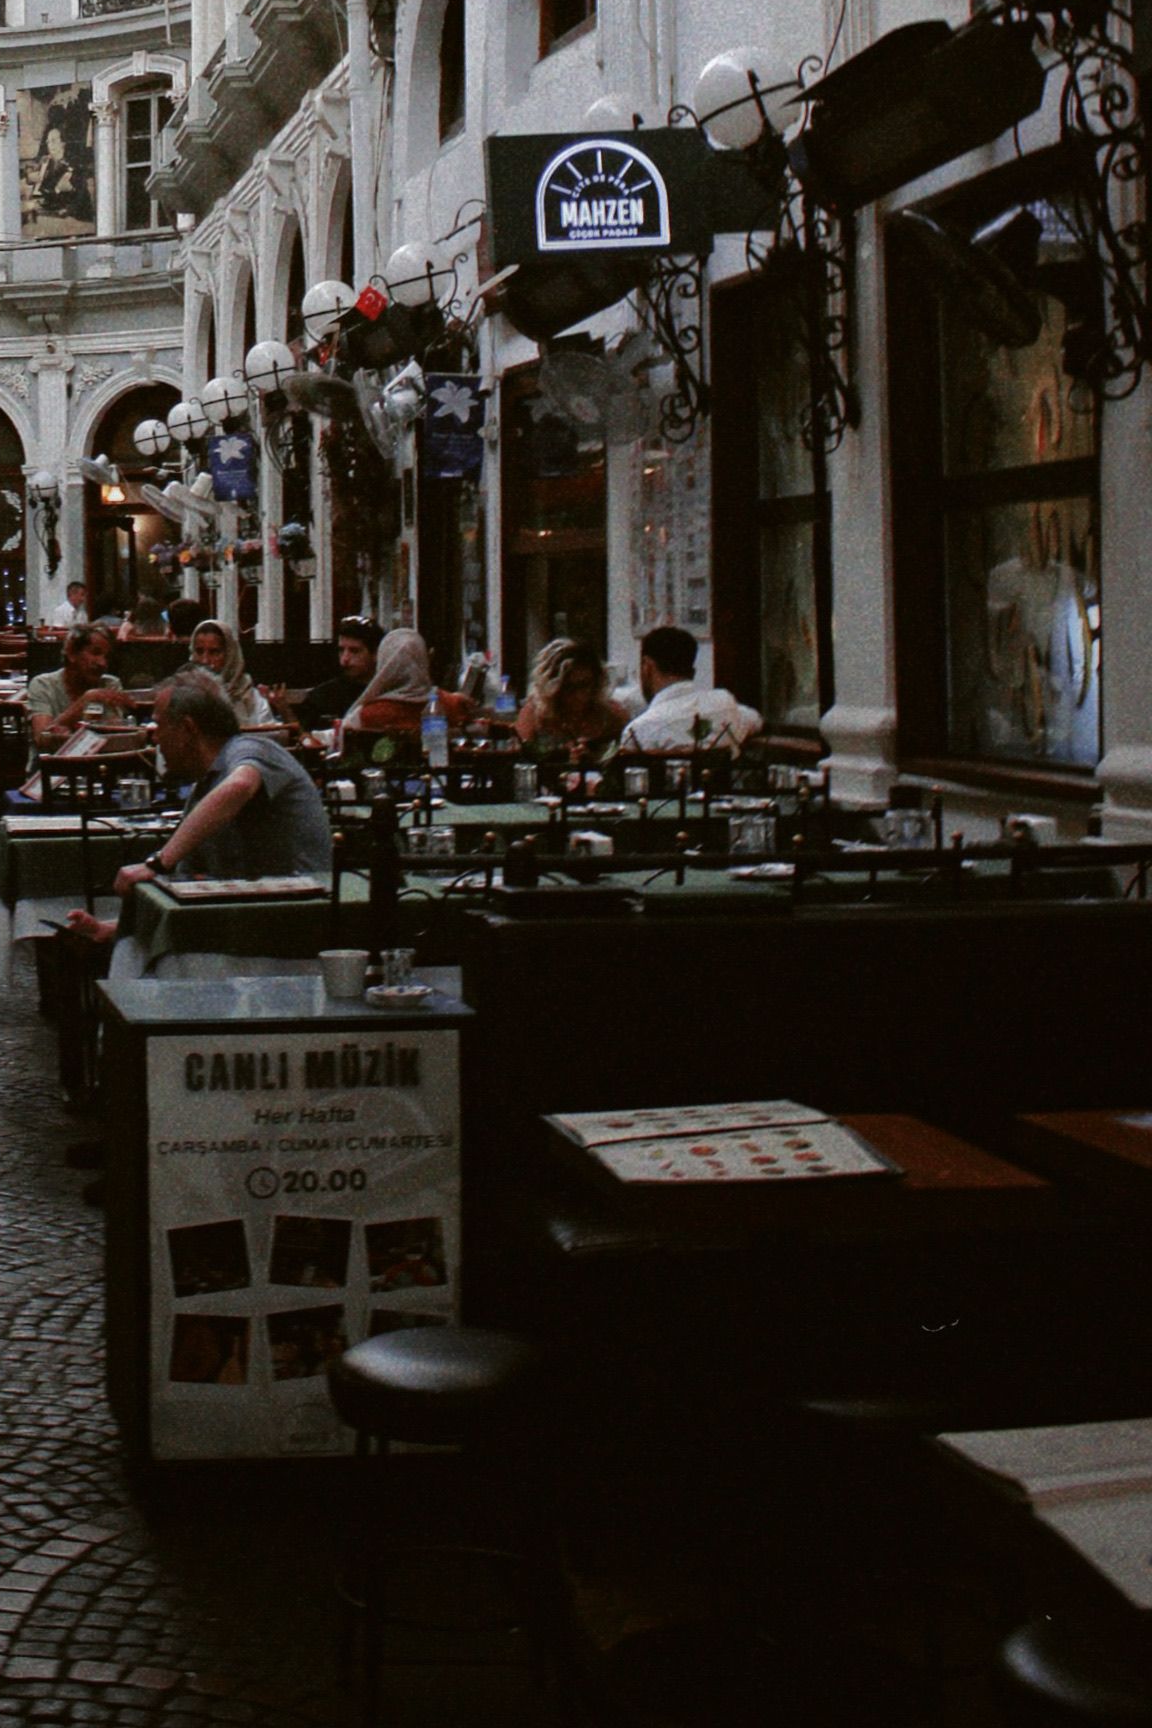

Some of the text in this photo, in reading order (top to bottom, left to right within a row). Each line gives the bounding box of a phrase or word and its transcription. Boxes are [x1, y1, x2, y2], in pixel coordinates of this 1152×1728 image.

[560, 198, 644, 228] MAHZEN
[185, 1042, 421, 1091] CANLI MÜZİK
[254, 1106, 356, 1124] Her Hafta
[278, 1138, 331, 1153] CUMA
[283, 1168, 367, 1194] 20.00
